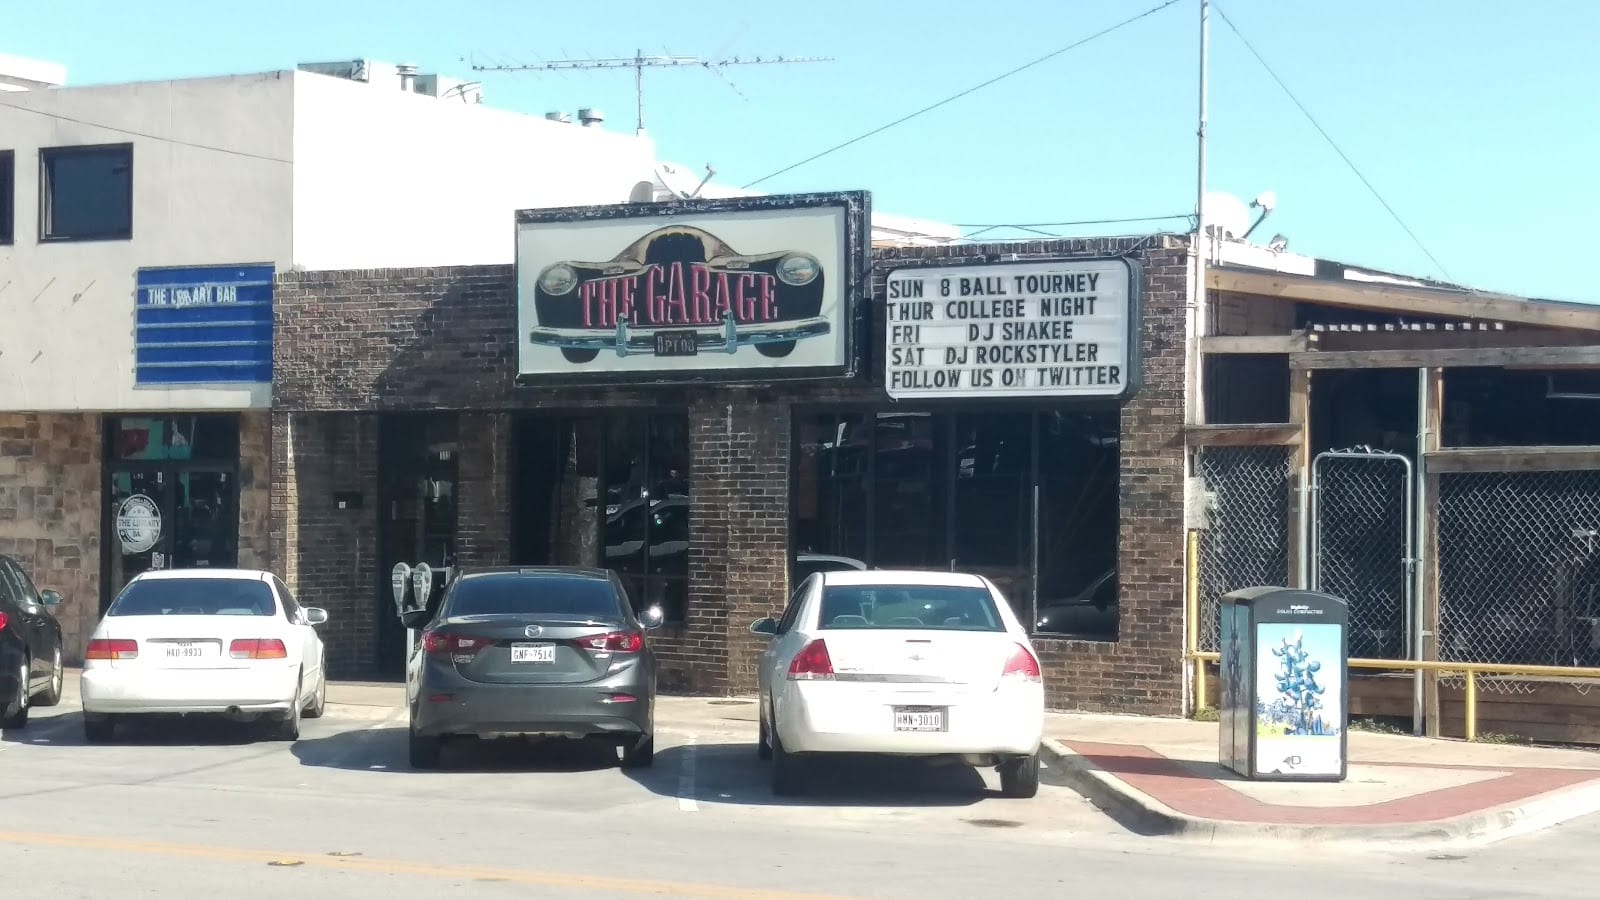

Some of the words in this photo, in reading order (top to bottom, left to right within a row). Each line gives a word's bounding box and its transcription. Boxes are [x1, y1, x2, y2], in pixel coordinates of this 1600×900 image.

[148, 287, 166, 304] THE
[217, 285, 237, 303] BAR
[578, 275, 638, 329] THE
[646, 261, 778, 324] GARAGE
[889, 280, 924, 298] SUN
[940, 278, 950, 296] 8
[960, 277, 1007, 296] BALL
[1014, 272, 1100, 294] TOURNEY
[886, 302, 934, 320] THUR
[946, 299, 1026, 319] COLLEGE
[1040, 296, 1098, 317] NIGHT
[892, 325, 920, 343] FRI
[969, 323, 994, 341] DJ
[1002, 321, 1073, 341] SHAKEE
[892, 347, 925, 366] SAT
[945, 346, 968, 365] DJ
[976, 343, 1098, 364] ROCKSTYLER
[891, 370, 961, 389] FOLLOW
[971, 369, 993, 387] US
[1001, 368, 1026, 386] ON
[1036, 365, 1120, 386] TWITTER
